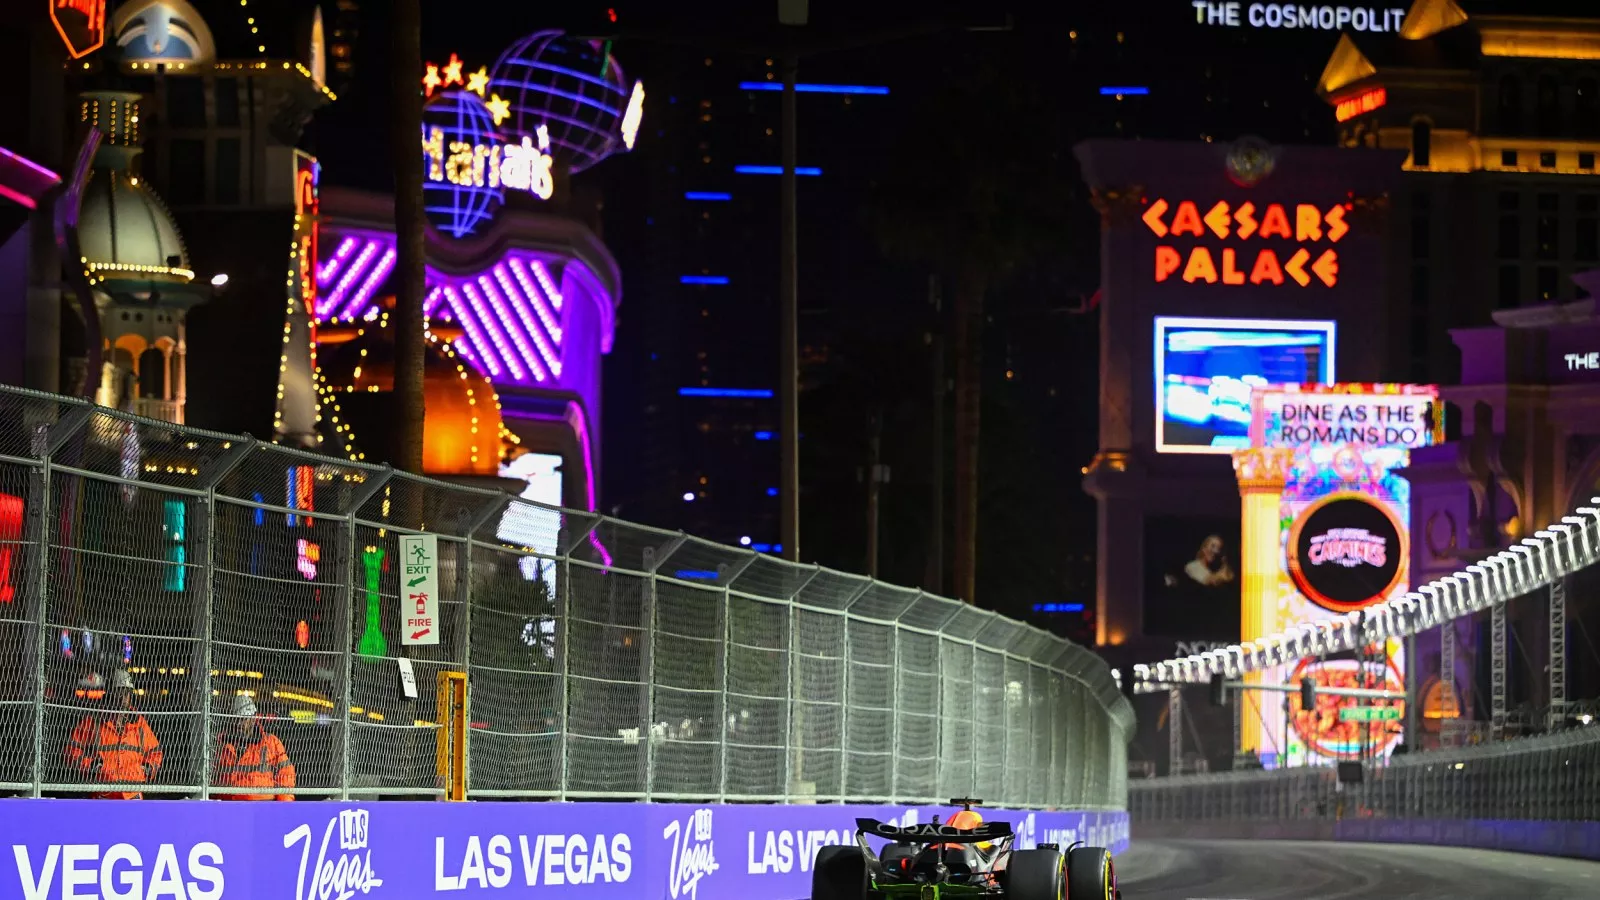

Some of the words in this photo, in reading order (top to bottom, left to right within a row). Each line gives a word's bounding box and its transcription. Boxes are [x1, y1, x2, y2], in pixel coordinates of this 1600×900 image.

[1192, 1, 1241, 27] THE
[1142, 198, 1349, 243] CAESARS
[1155, 246, 1339, 288] PALACE
[1564, 352, 1600, 371] THE
[1281, 404, 1333, 422] DINE
[1339, 404, 1368, 422] AS
[1374, 405, 1415, 422] THE
[1281, 426, 1379, 444] ROMANS
[1385, 427, 1417, 445] DO
[406, 566, 432, 575] EXIT
[407, 618, 432, 627] FIRE
[342, 812, 367, 847] LAS
[12, 842, 225, 900] VEGAS
[283, 816, 383, 900] Vegas
[435, 834, 512, 891] LAS
[519, 833, 632, 887] VEGAS
[664, 814, 720, 900] Vegas
[747, 830, 794, 874] LAS
